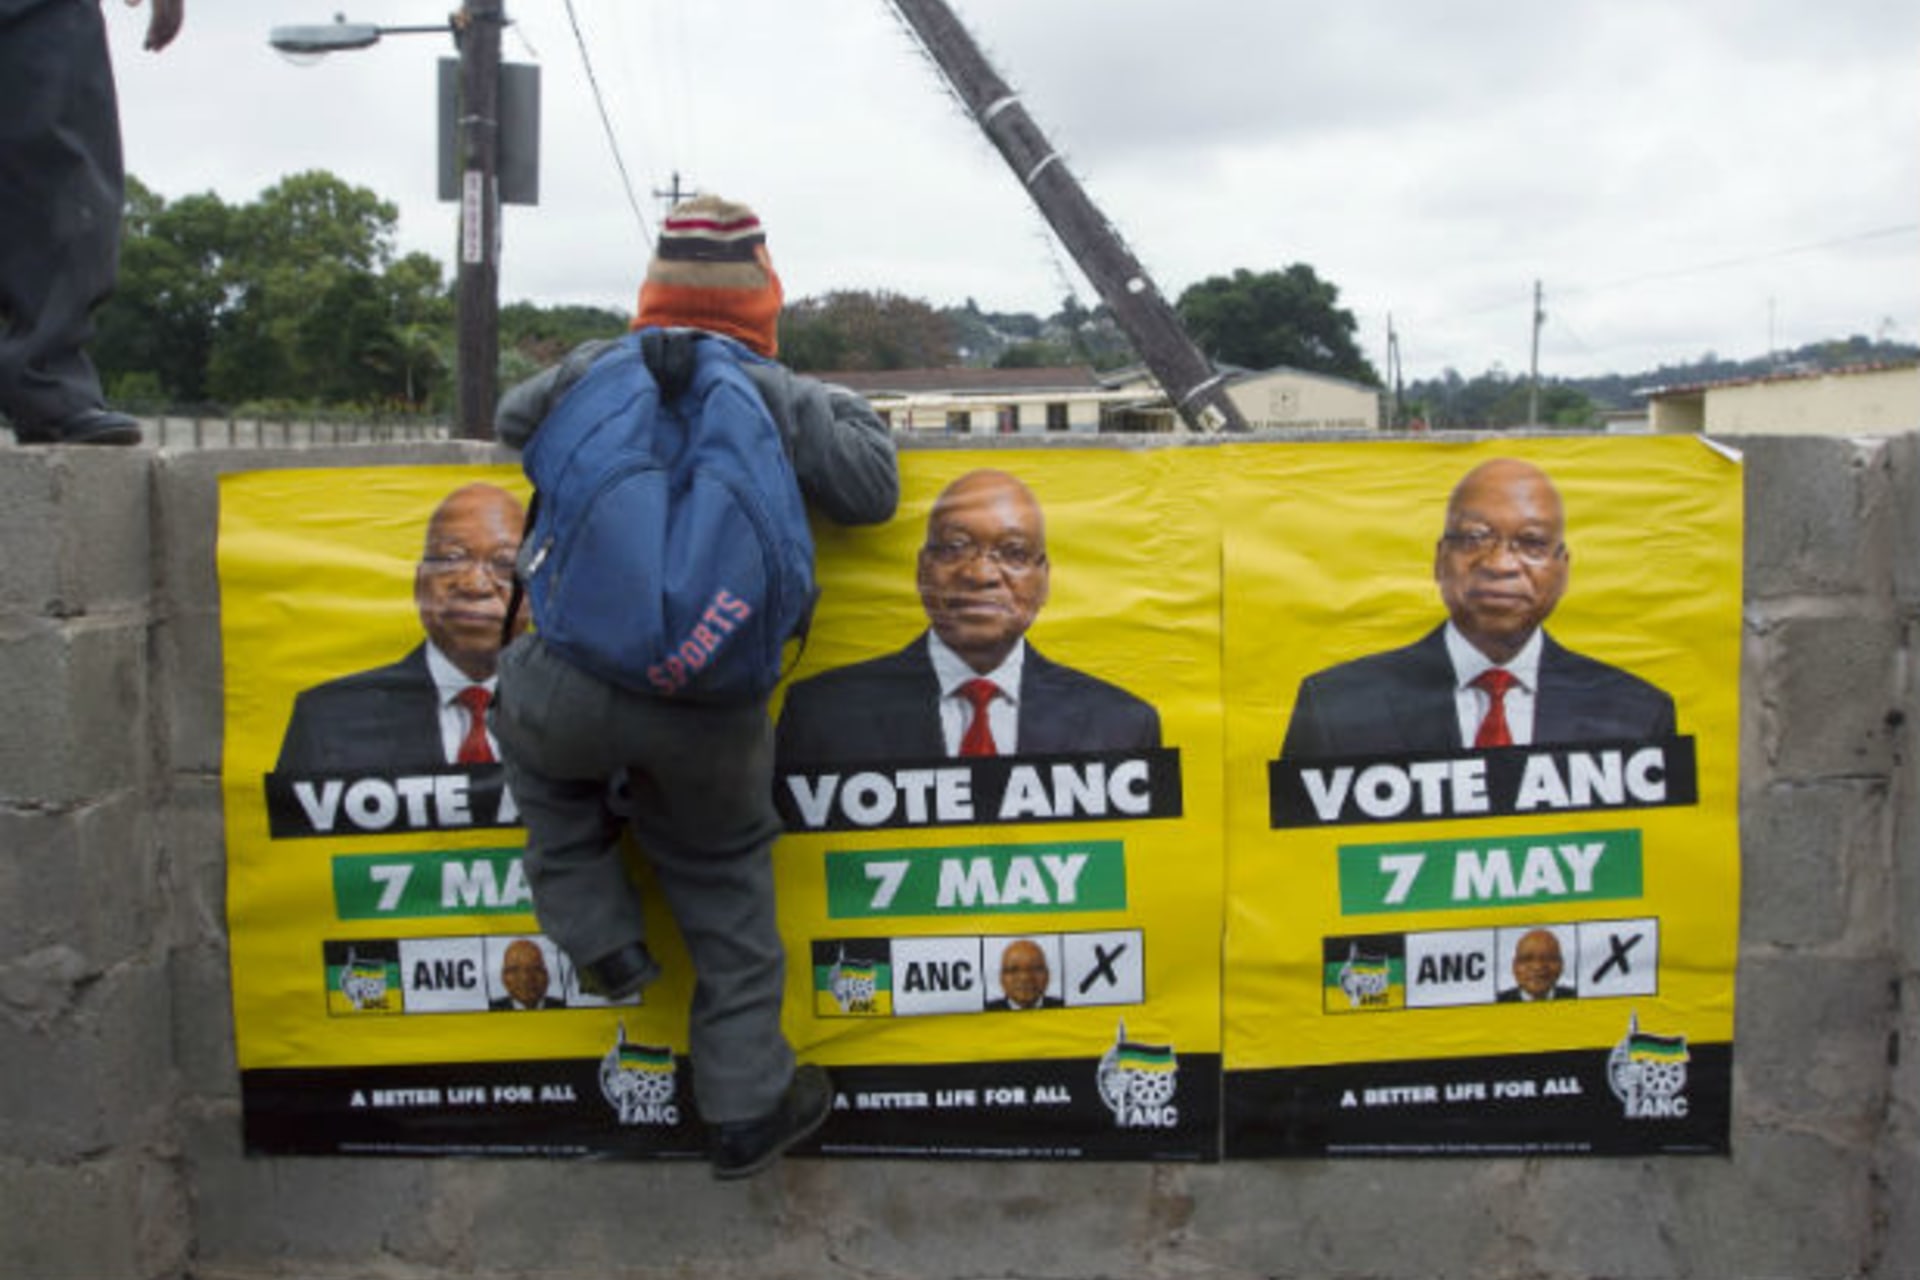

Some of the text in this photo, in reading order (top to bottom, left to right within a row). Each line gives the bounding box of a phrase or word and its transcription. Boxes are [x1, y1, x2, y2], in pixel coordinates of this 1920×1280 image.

[648, 589, 750, 695] SPORTS
[787, 760, 1152, 826] VOTE ANC
[1300, 747, 1667, 821] VOTE ANC
[294, 775, 472, 831] VOTE
[369, 858, 534, 911] 7 MA
[863, 853, 1090, 910] 7 MAY
[1378, 842, 1607, 905] 7 MAY
[412, 959, 478, 991] ANC
[903, 961, 974, 993] ANC
[1416, 951, 1486, 985] ANC
[351, 1085, 577, 1107] A BETTER LIFE FOR ALL
[834, 1086, 1072, 1109] A BETTER LIFE FOR ALL
[1340, 1077, 1582, 1108] A BETTER LIFE FOR ALL
[1640, 1095, 1690, 1118] ANC
[634, 1104, 680, 1125] ANC
[1129, 1104, 1179, 1128] ANC
